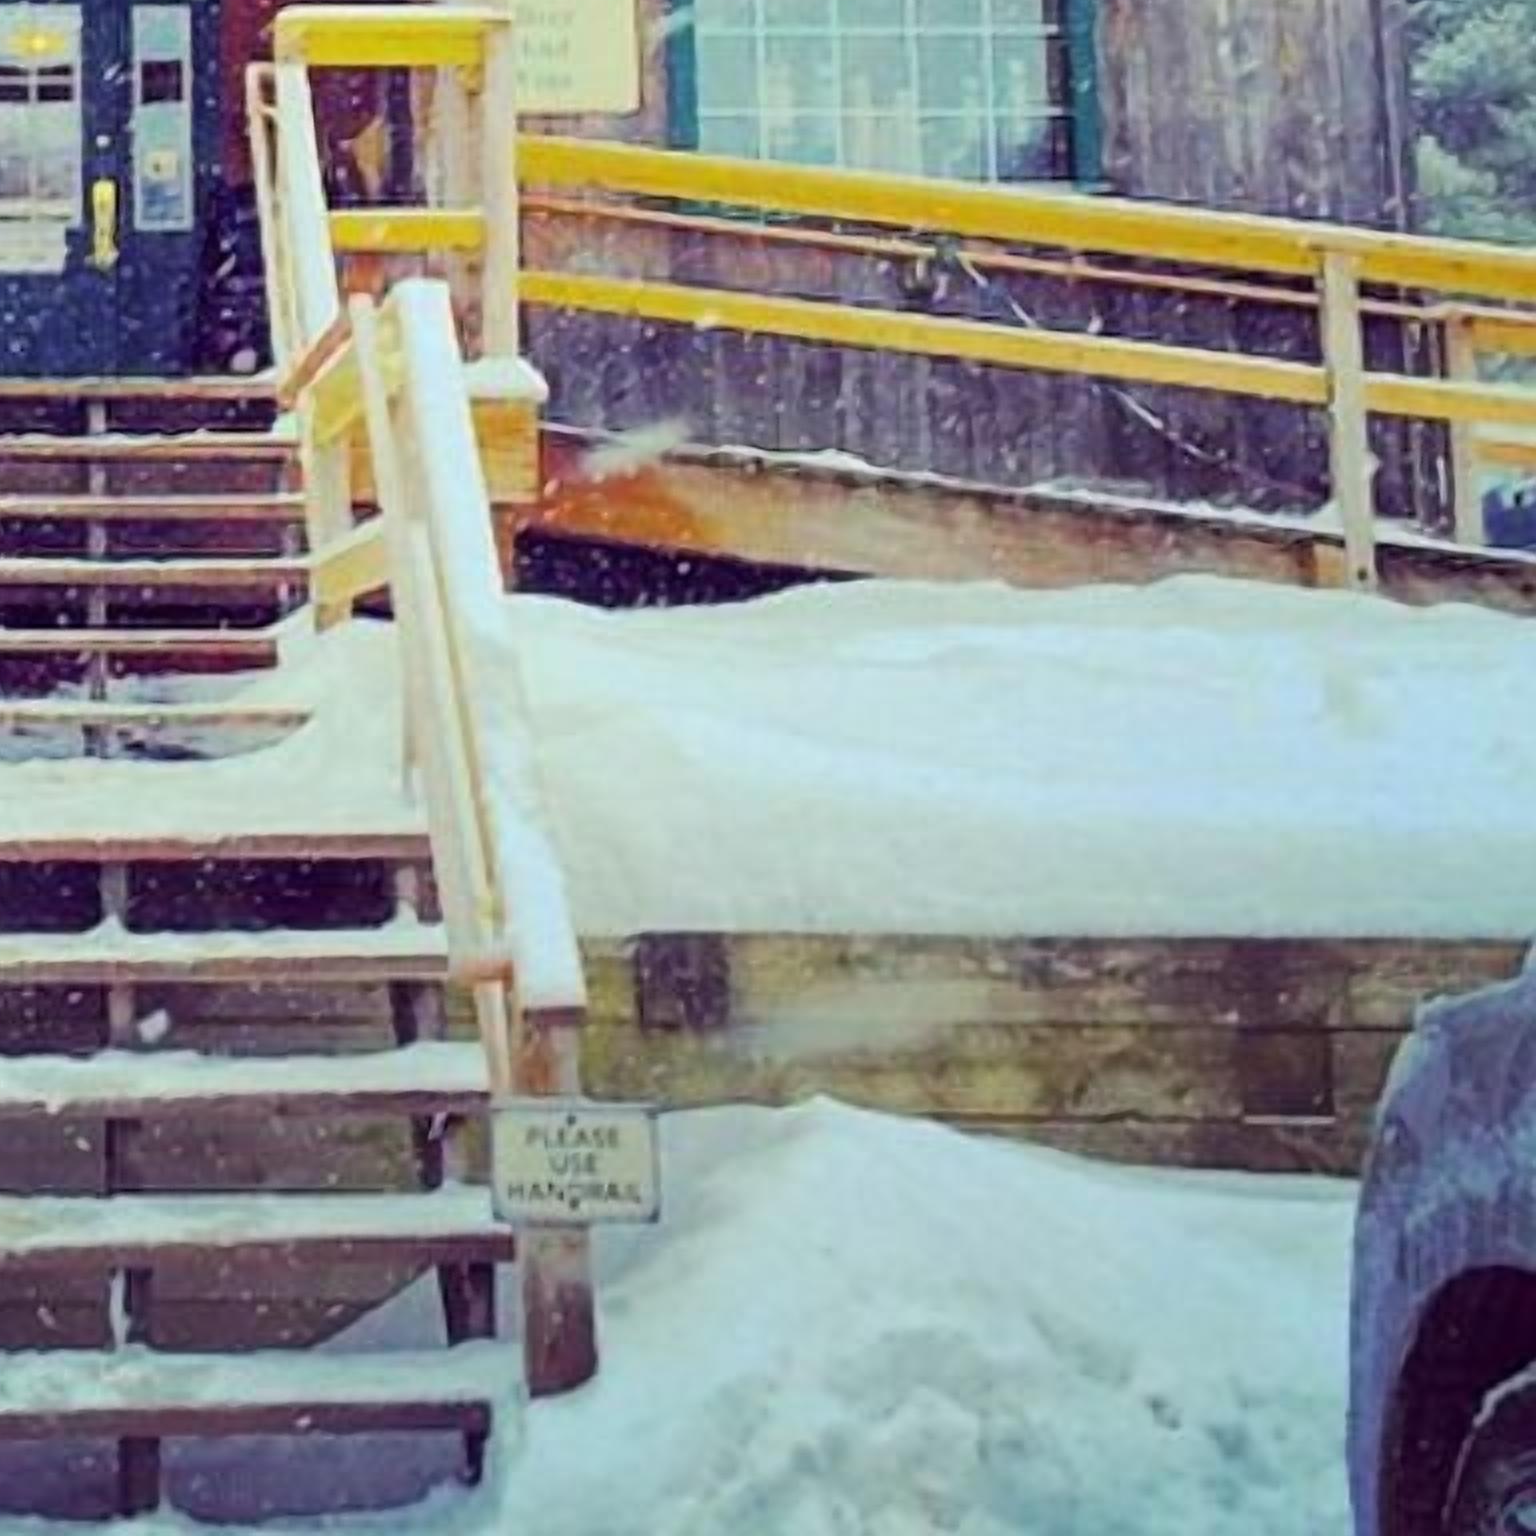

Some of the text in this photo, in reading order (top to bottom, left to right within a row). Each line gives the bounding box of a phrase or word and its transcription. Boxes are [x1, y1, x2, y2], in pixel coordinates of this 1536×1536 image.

[526, 1126, 620, 1148] PLEASE
[548, 1152, 597, 1175] USE
[507, 1182, 642, 1204] HANDRAIL
